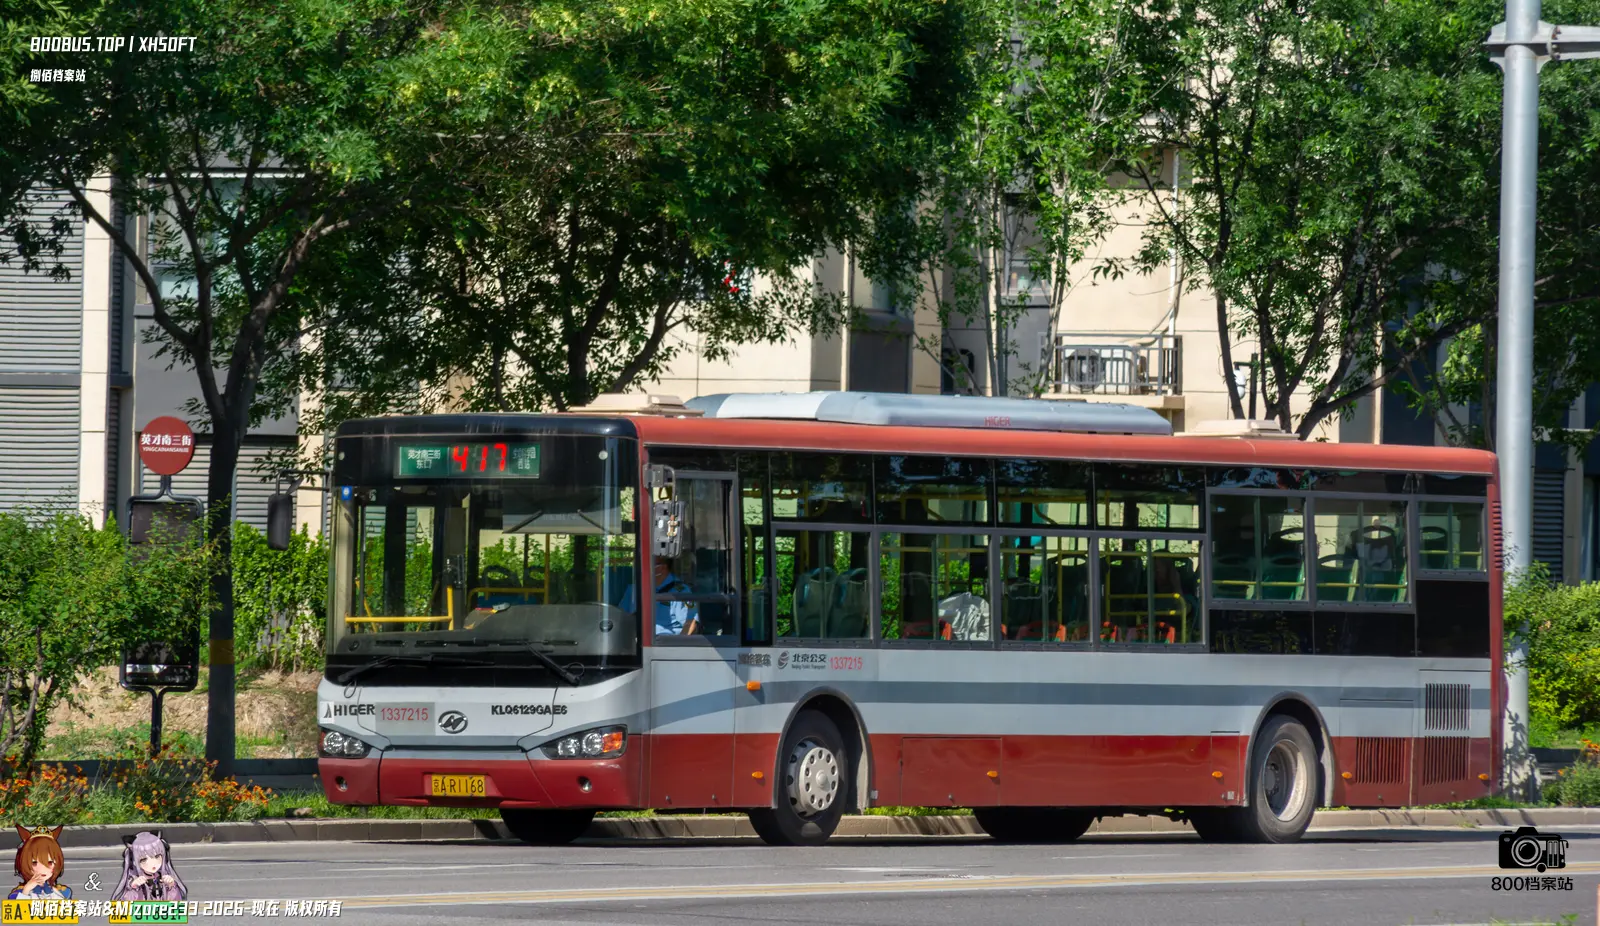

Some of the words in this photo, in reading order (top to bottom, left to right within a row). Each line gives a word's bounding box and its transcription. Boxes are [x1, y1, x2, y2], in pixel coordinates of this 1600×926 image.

[141, 433, 191, 445] 英才南三街
[452, 443, 507, 472] 417
[792, 653, 827, 663] 北京公交
[830, 656, 863, 670] 1337215
[334, 704, 375, 716] HIGER
[381, 708, 428, 721] 1337215
[491, 705, 568, 715] KLQ6129GAE6
